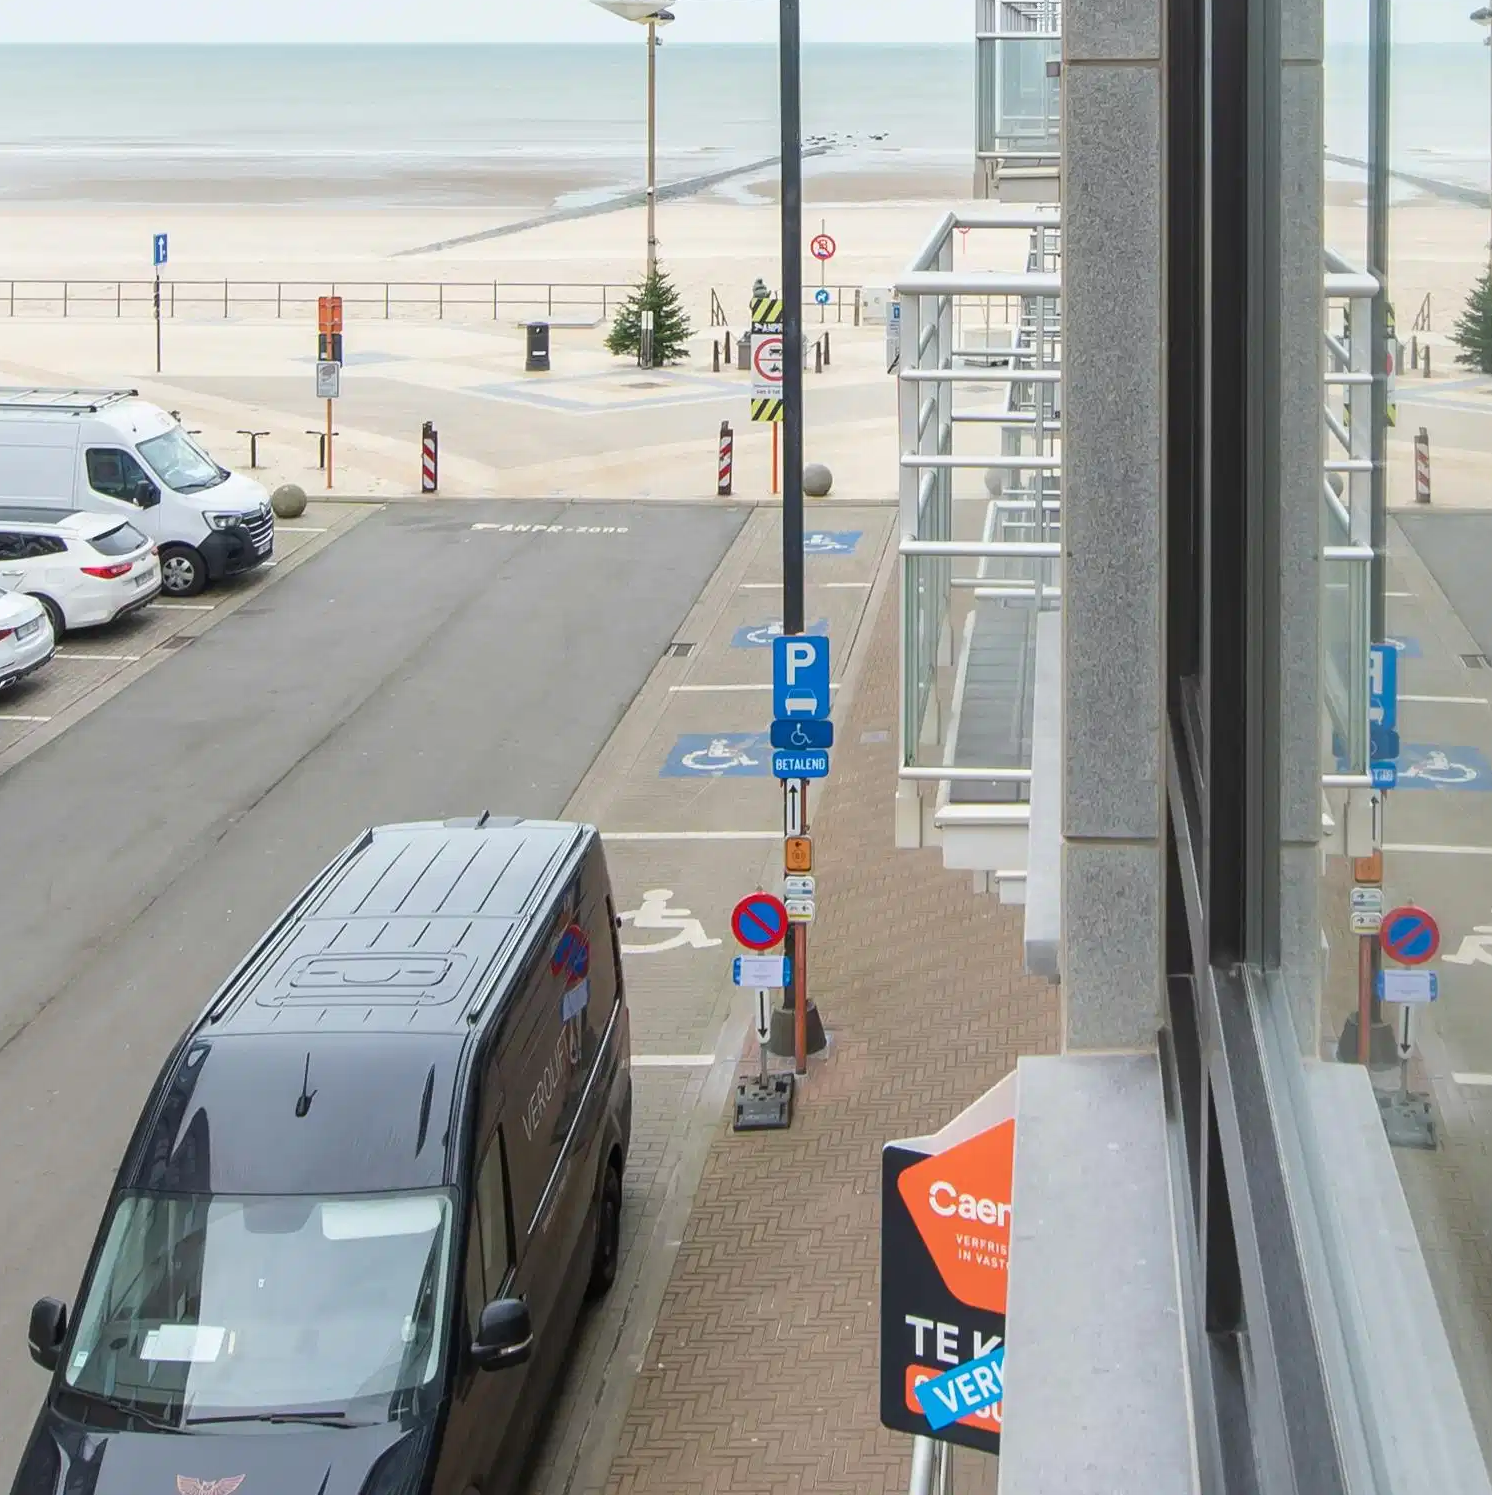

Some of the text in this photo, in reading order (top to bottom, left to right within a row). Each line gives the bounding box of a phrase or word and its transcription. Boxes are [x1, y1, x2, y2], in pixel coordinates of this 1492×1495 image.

[786, 642, 816, 685] P
[775, 757, 826, 771] BETALEND
[958, 1248, 971, 1262] IN
[905, 1313, 959, 1365] TE
